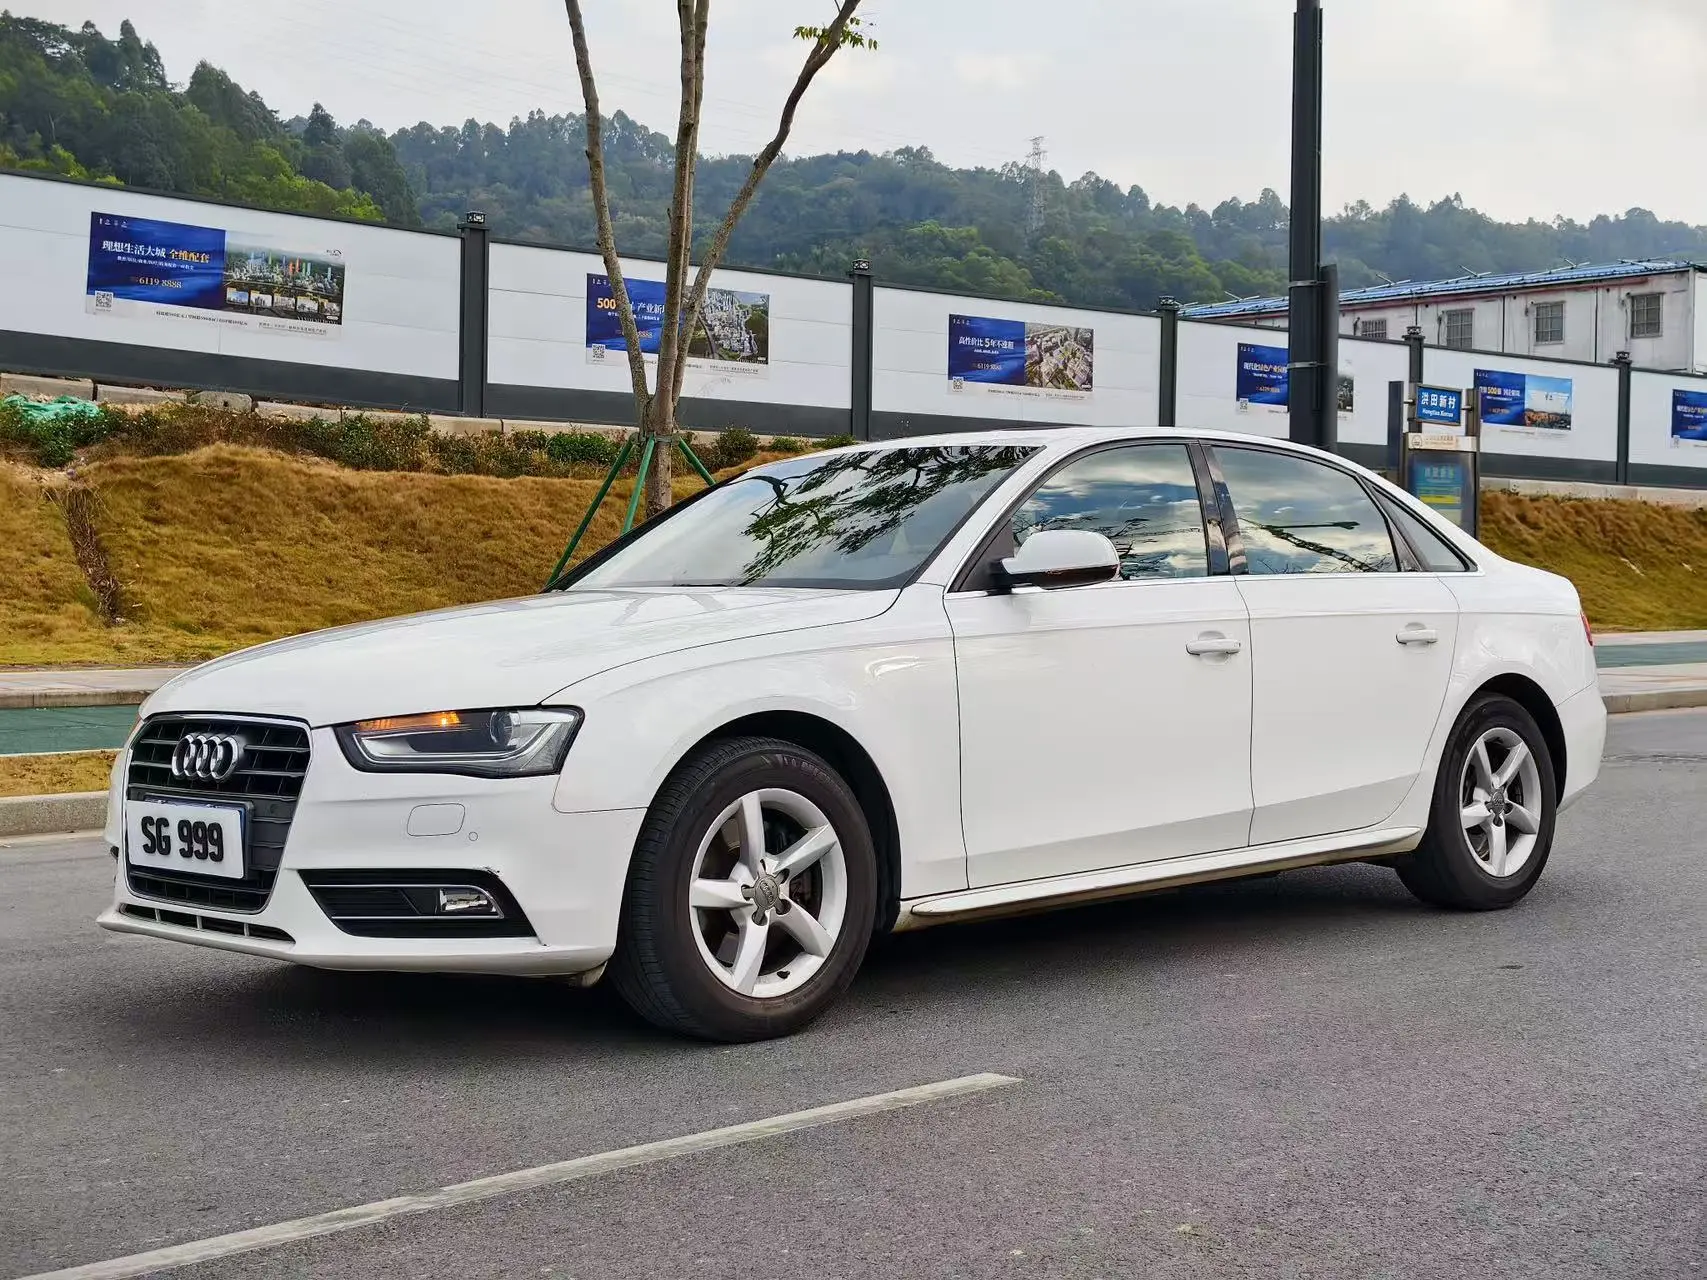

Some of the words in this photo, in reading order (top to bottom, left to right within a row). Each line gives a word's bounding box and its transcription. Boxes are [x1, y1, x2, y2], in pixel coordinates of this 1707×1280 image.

[102, 240, 166, 258] 理想生活大城
[169, 248, 210, 264] 全维配套
[139, 276, 159, 286] 6119
[141, 815, 171, 856] SG
[177, 818, 224, 863] 999
